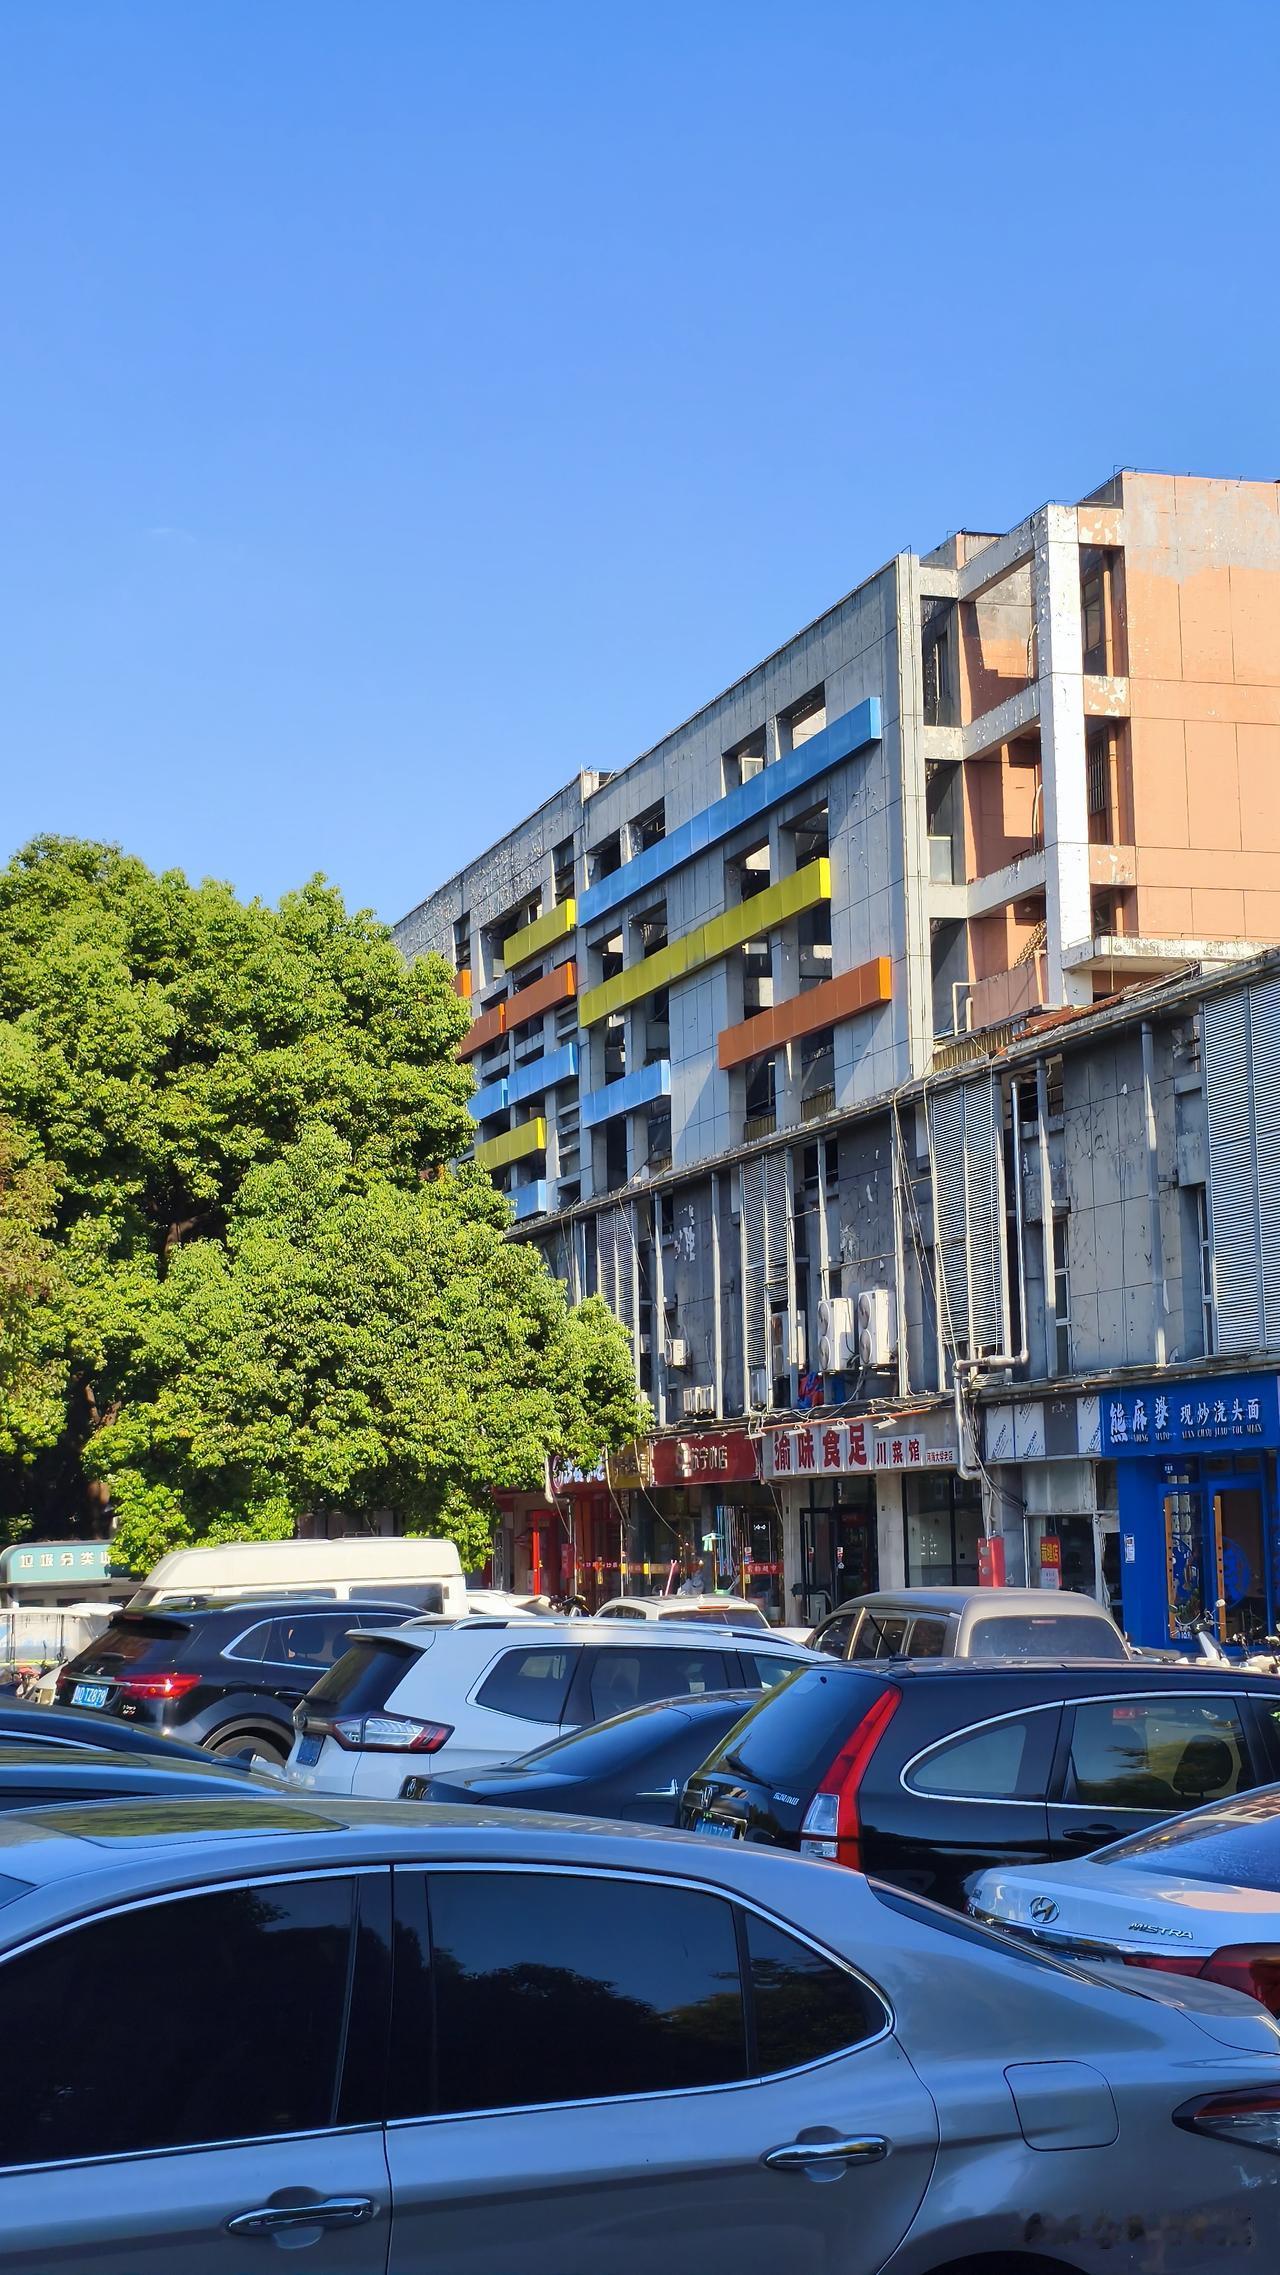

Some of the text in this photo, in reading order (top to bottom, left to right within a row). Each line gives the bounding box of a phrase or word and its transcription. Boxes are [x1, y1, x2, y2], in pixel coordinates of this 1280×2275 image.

[1181, 1398, 1260, 1426] 现炒浇头面
[774, 1423, 868, 1471] 渝味食足
[876, 1439, 921, 1465] 川菜馆
[1129, 1923, 1193, 1939] MISTRA
